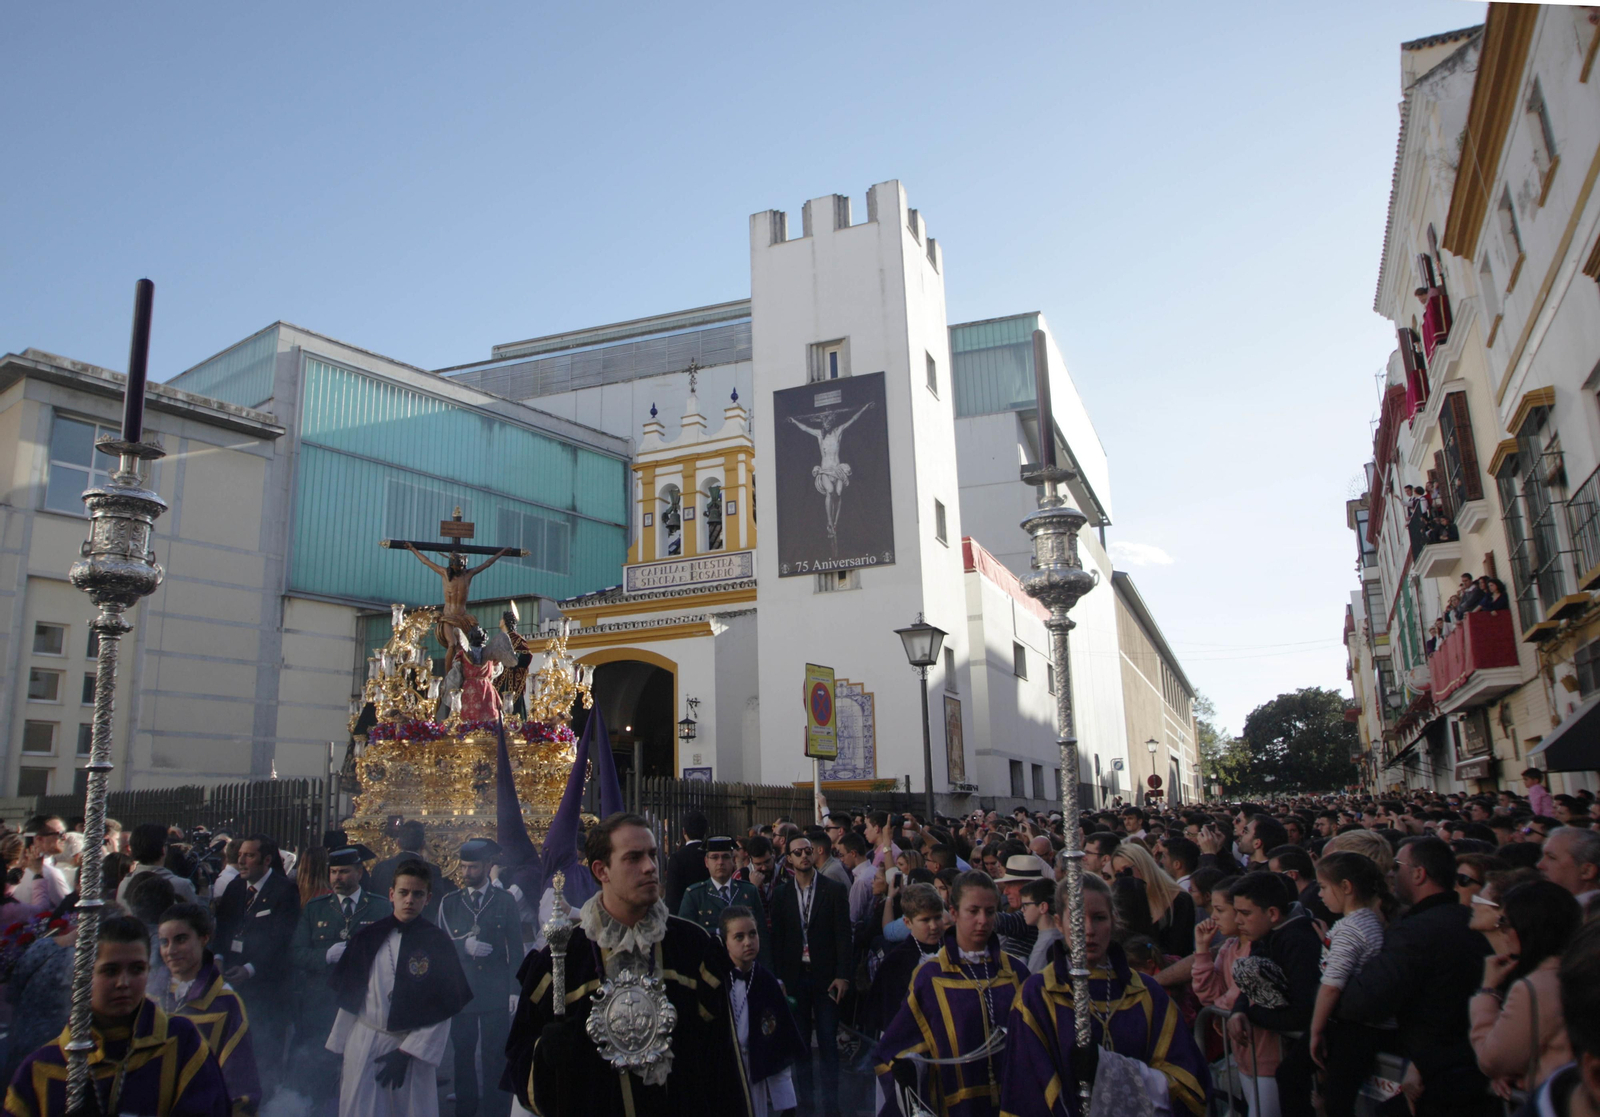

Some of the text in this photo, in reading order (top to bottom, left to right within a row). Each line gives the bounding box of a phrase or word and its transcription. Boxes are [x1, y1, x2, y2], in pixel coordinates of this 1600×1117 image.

[641, 565, 680, 577] CAPILLA
[690, 557, 735, 571] NUESTRA
[795, 553, 877, 573] 75 Aniversario
[690, 567, 735, 581] ROSARIO
